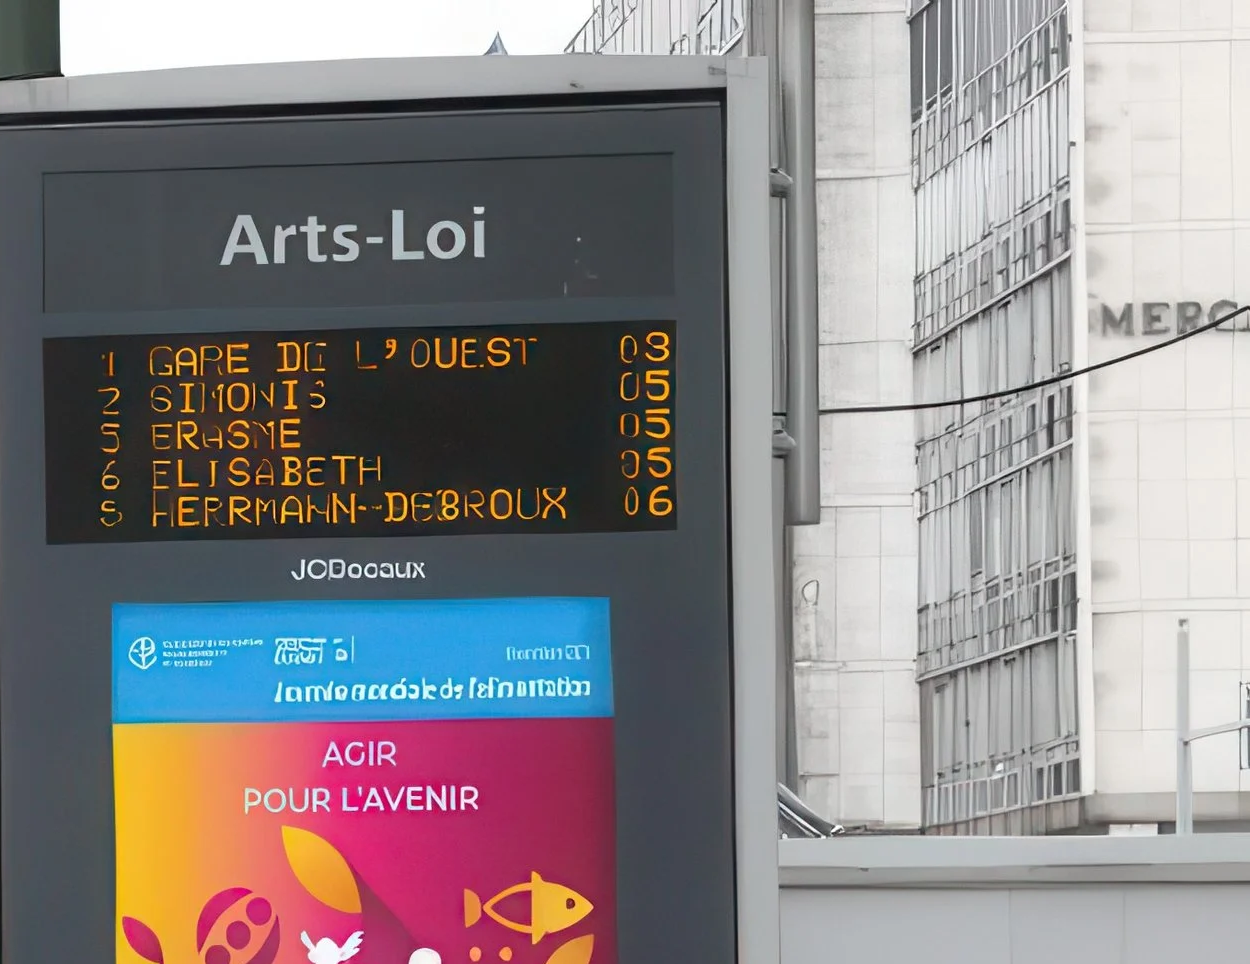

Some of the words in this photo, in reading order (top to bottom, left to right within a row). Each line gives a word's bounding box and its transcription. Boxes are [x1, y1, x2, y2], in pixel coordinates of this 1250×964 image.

[219, 206, 485, 266] Arts-Loi
[1100, 299, 1250, 336] MERC
[101, 351, 115, 377] 1
[150, 342, 250, 377] GARE
[619, 331, 670, 364] 03
[97, 387, 121, 415] 2
[150, 379, 327, 414] SIMONIS
[619, 369, 670, 402] 05
[100, 423, 121, 453] 5
[151, 418, 301, 451] ERASME
[619, 408, 671, 439] 05
[101, 460, 121, 490] 6
[152, 455, 382, 488] ELISABETH
[620, 447, 672, 480] 05
[623, 485, 674, 517] 06
[322, 741, 397, 768] AGIR
[244, 787, 331, 815] POUR
[341, 784, 480, 813] L'AVENIR
